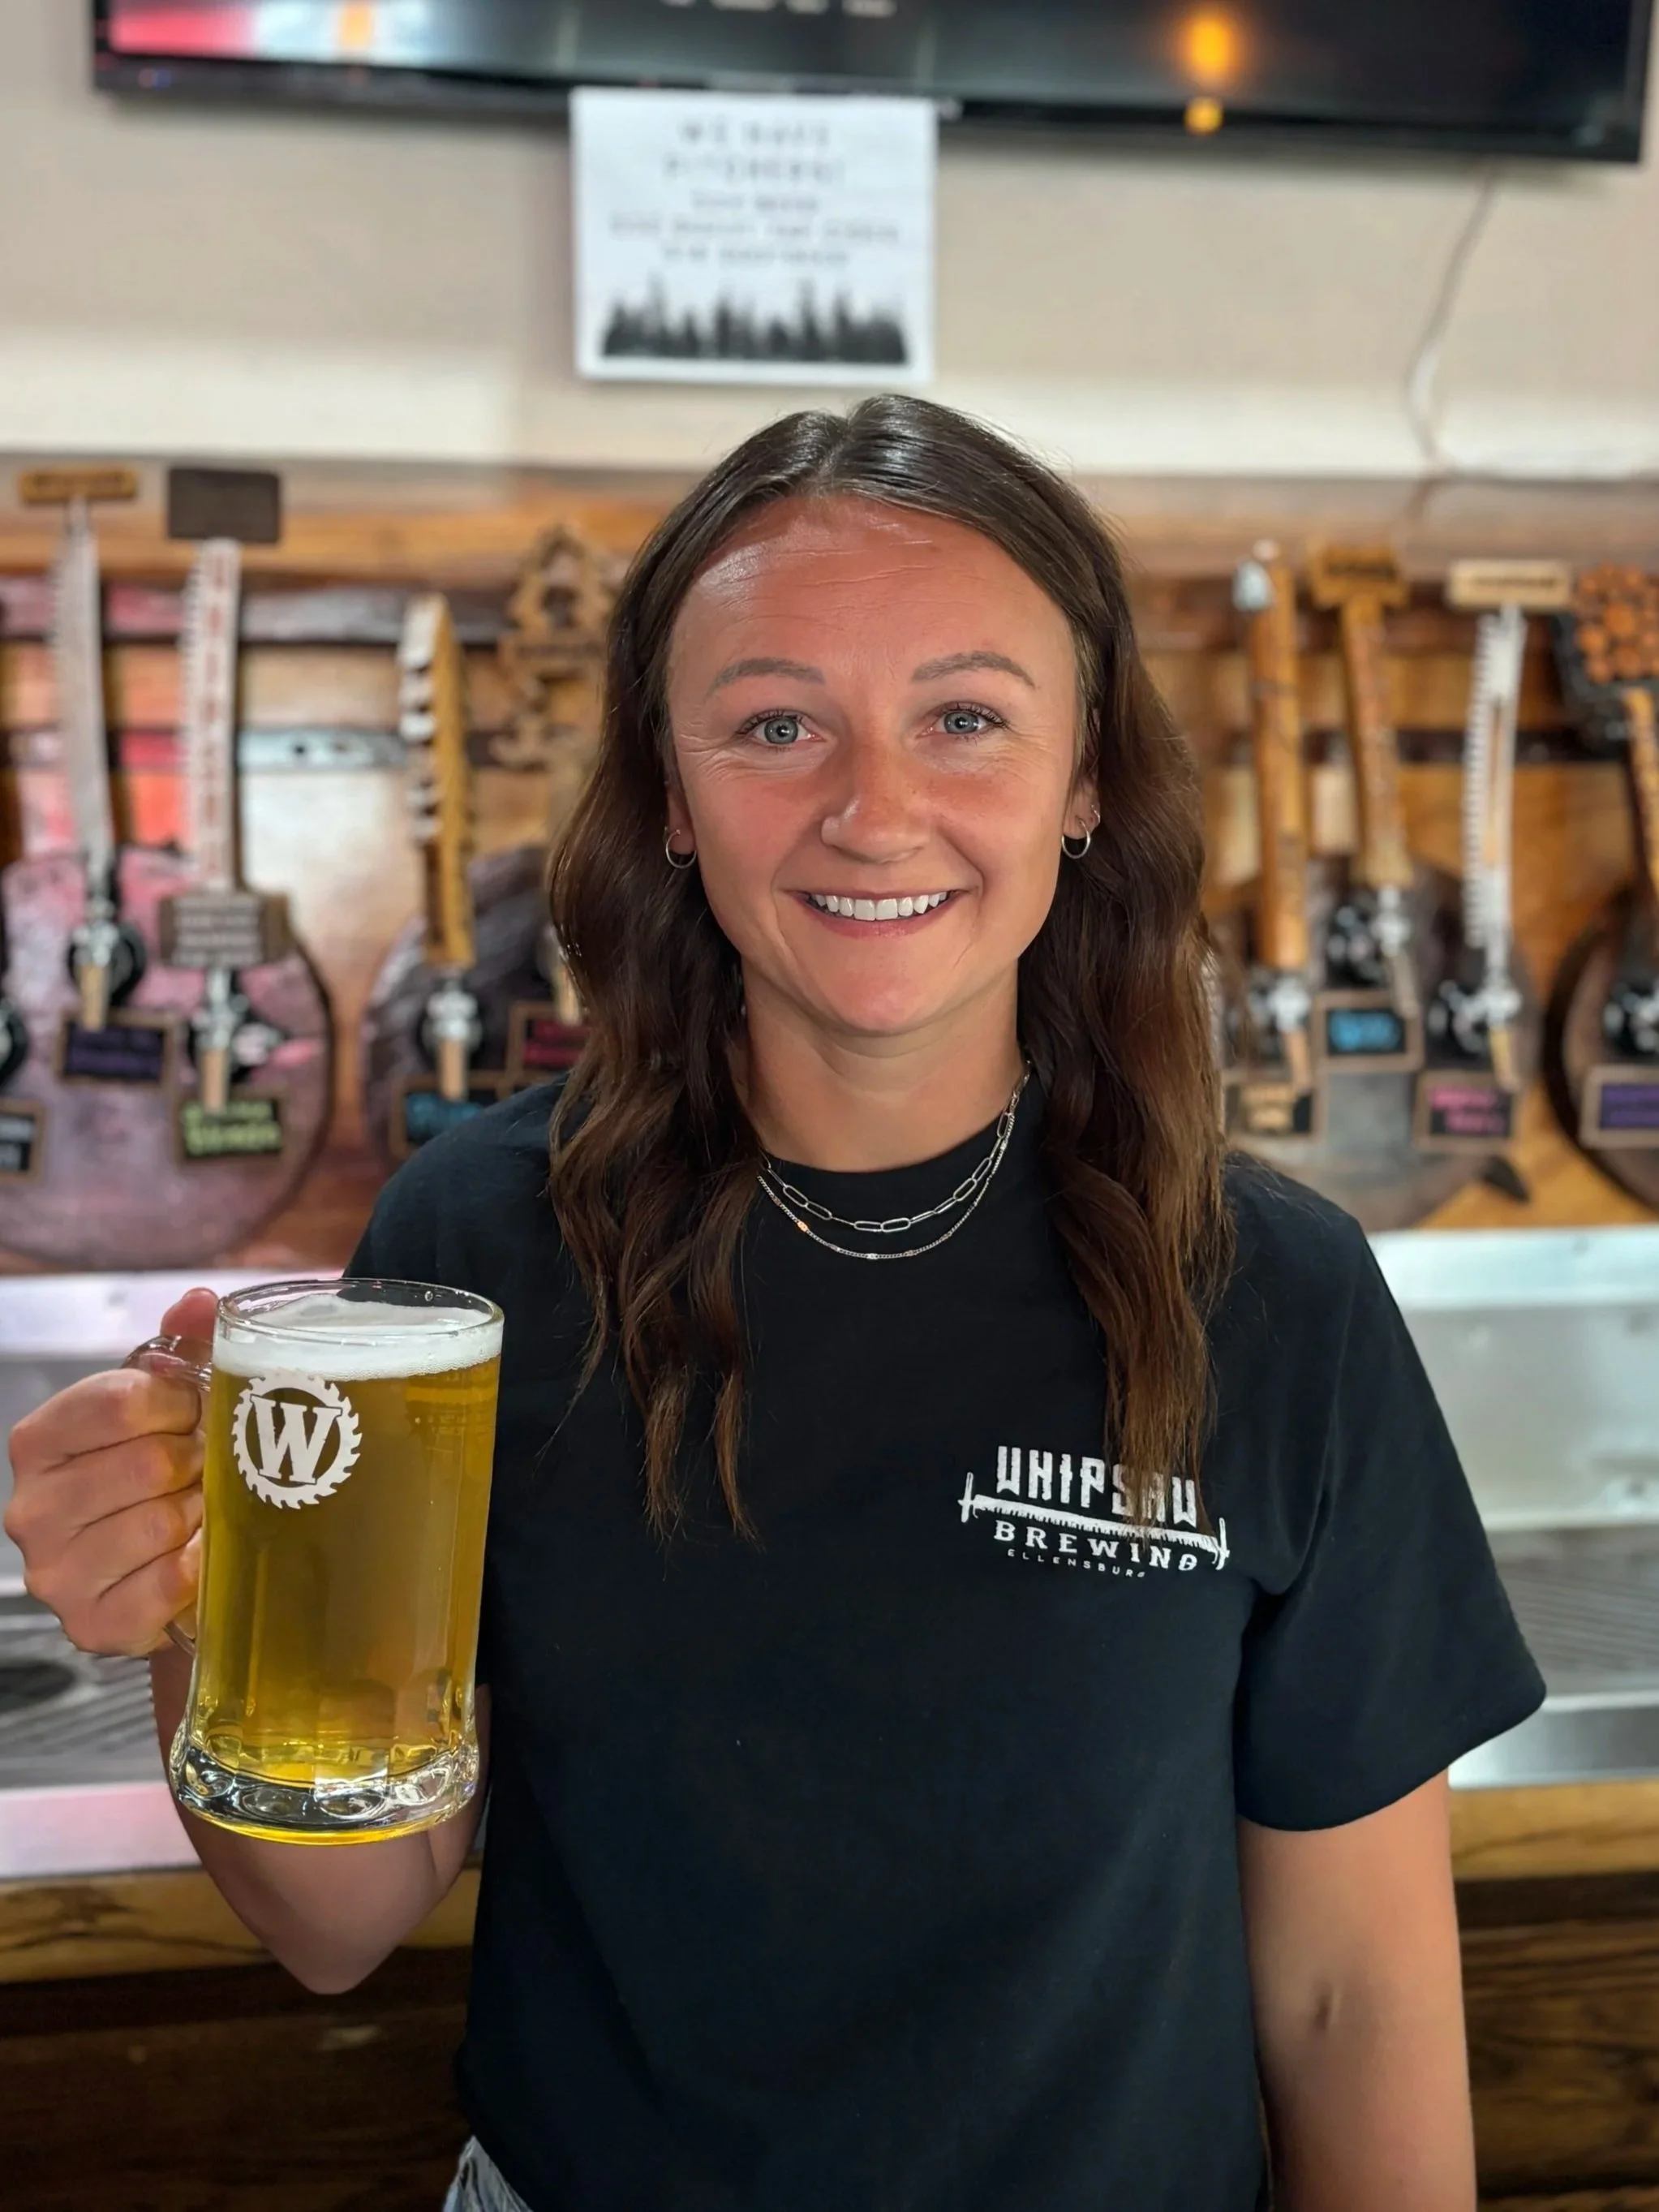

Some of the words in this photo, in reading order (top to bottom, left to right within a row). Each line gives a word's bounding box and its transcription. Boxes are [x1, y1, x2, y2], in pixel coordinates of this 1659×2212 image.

[251, 1395, 342, 1484] W
[994, 1520, 1197, 1571] BREWING
[1008, 1548, 1145, 1577] ELLENSBURG
